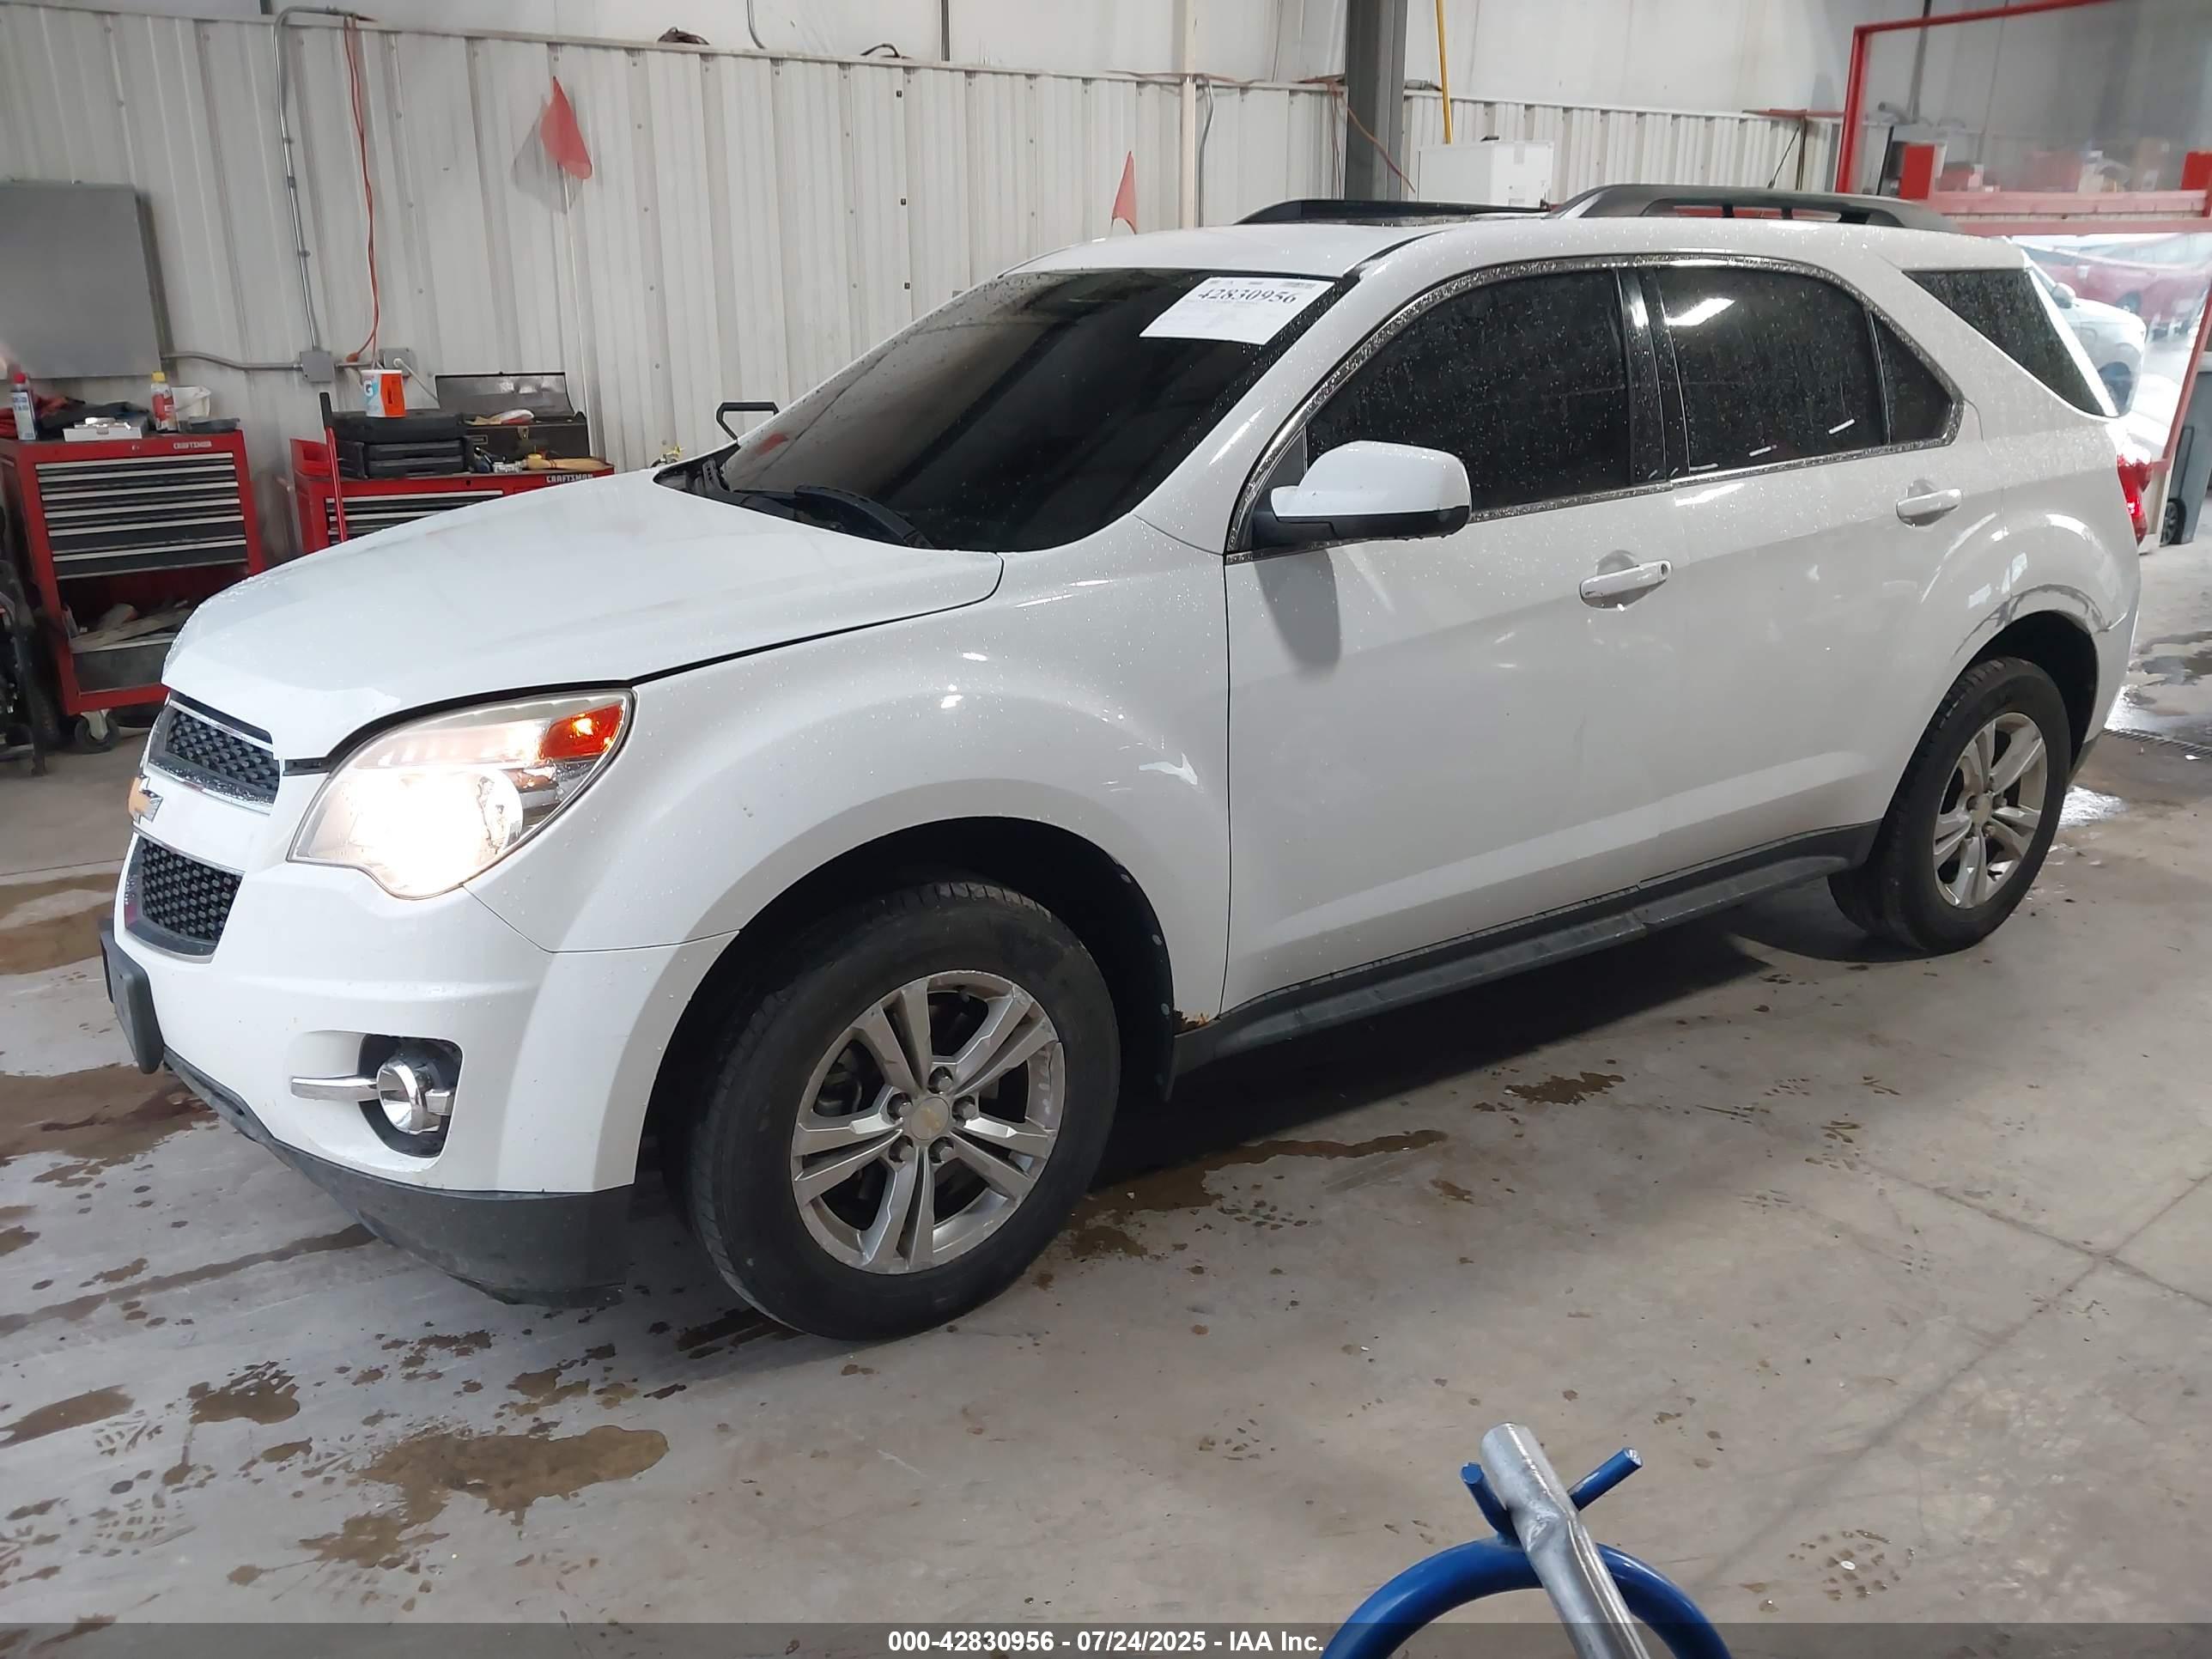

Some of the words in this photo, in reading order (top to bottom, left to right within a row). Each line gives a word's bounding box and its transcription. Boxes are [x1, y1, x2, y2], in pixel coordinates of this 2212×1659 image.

[1197, 288, 1297, 303] 42830956
[363, 380, 374, 398] G
[546, 473, 593, 483] CRAFTSMAN
